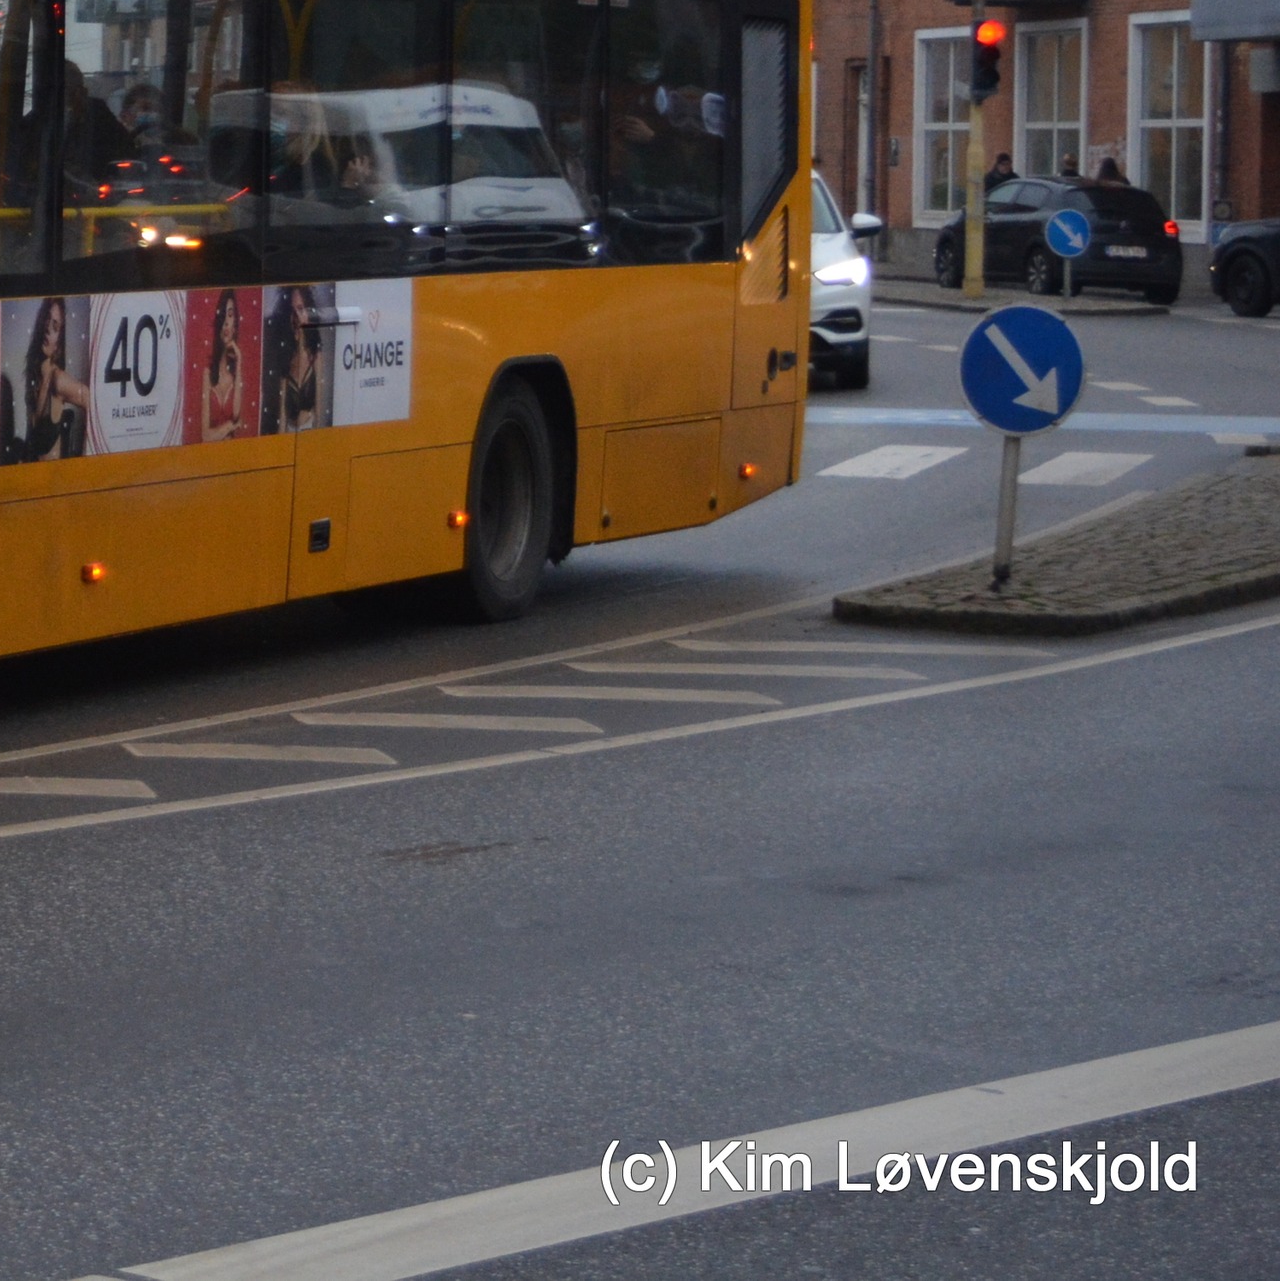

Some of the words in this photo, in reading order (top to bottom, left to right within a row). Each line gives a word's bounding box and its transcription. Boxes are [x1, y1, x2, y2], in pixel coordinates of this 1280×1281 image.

[104, 314, 171, 398] 40%
[342, 340, 404, 371] CHANGE
[121, 404, 136, 419] ALLE
